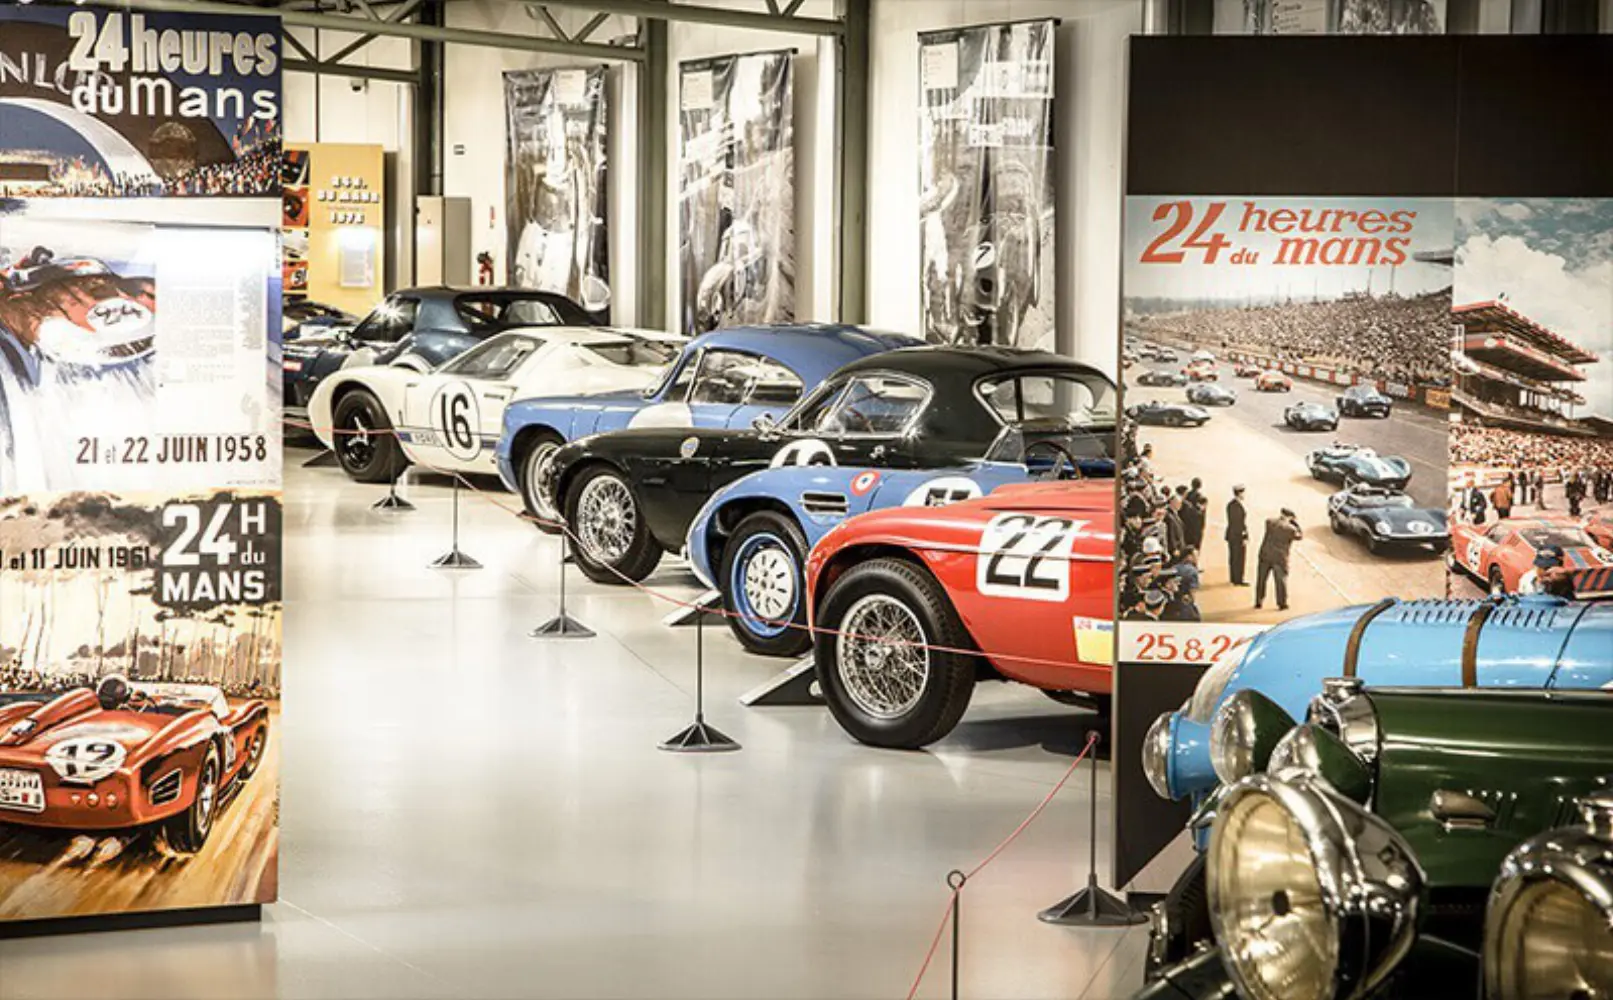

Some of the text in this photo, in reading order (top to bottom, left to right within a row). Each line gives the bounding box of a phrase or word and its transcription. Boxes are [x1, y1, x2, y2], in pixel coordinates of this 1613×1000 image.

[69, 11, 278, 76] 24 heures
[71, 75, 278, 119] du mans
[1140, 201, 1417, 264] 24 heures
[1230, 237, 1412, 266] du mans
[440, 393, 473, 450] 16
[77, 435, 267, 464] 21 et 22 JUIN 1958
[162, 503, 236, 566] 24
[240, 540, 265, 565] du
[986, 515, 1073, 590] 22
[31, 548, 45, 569] 11
[54, 547, 99, 569] JUIN
[108, 546, 150, 569] 1961
[162, 570, 265, 601] MANS
[1136, 633, 1178, 660] 25
[1183, 639, 1204, 661] &
